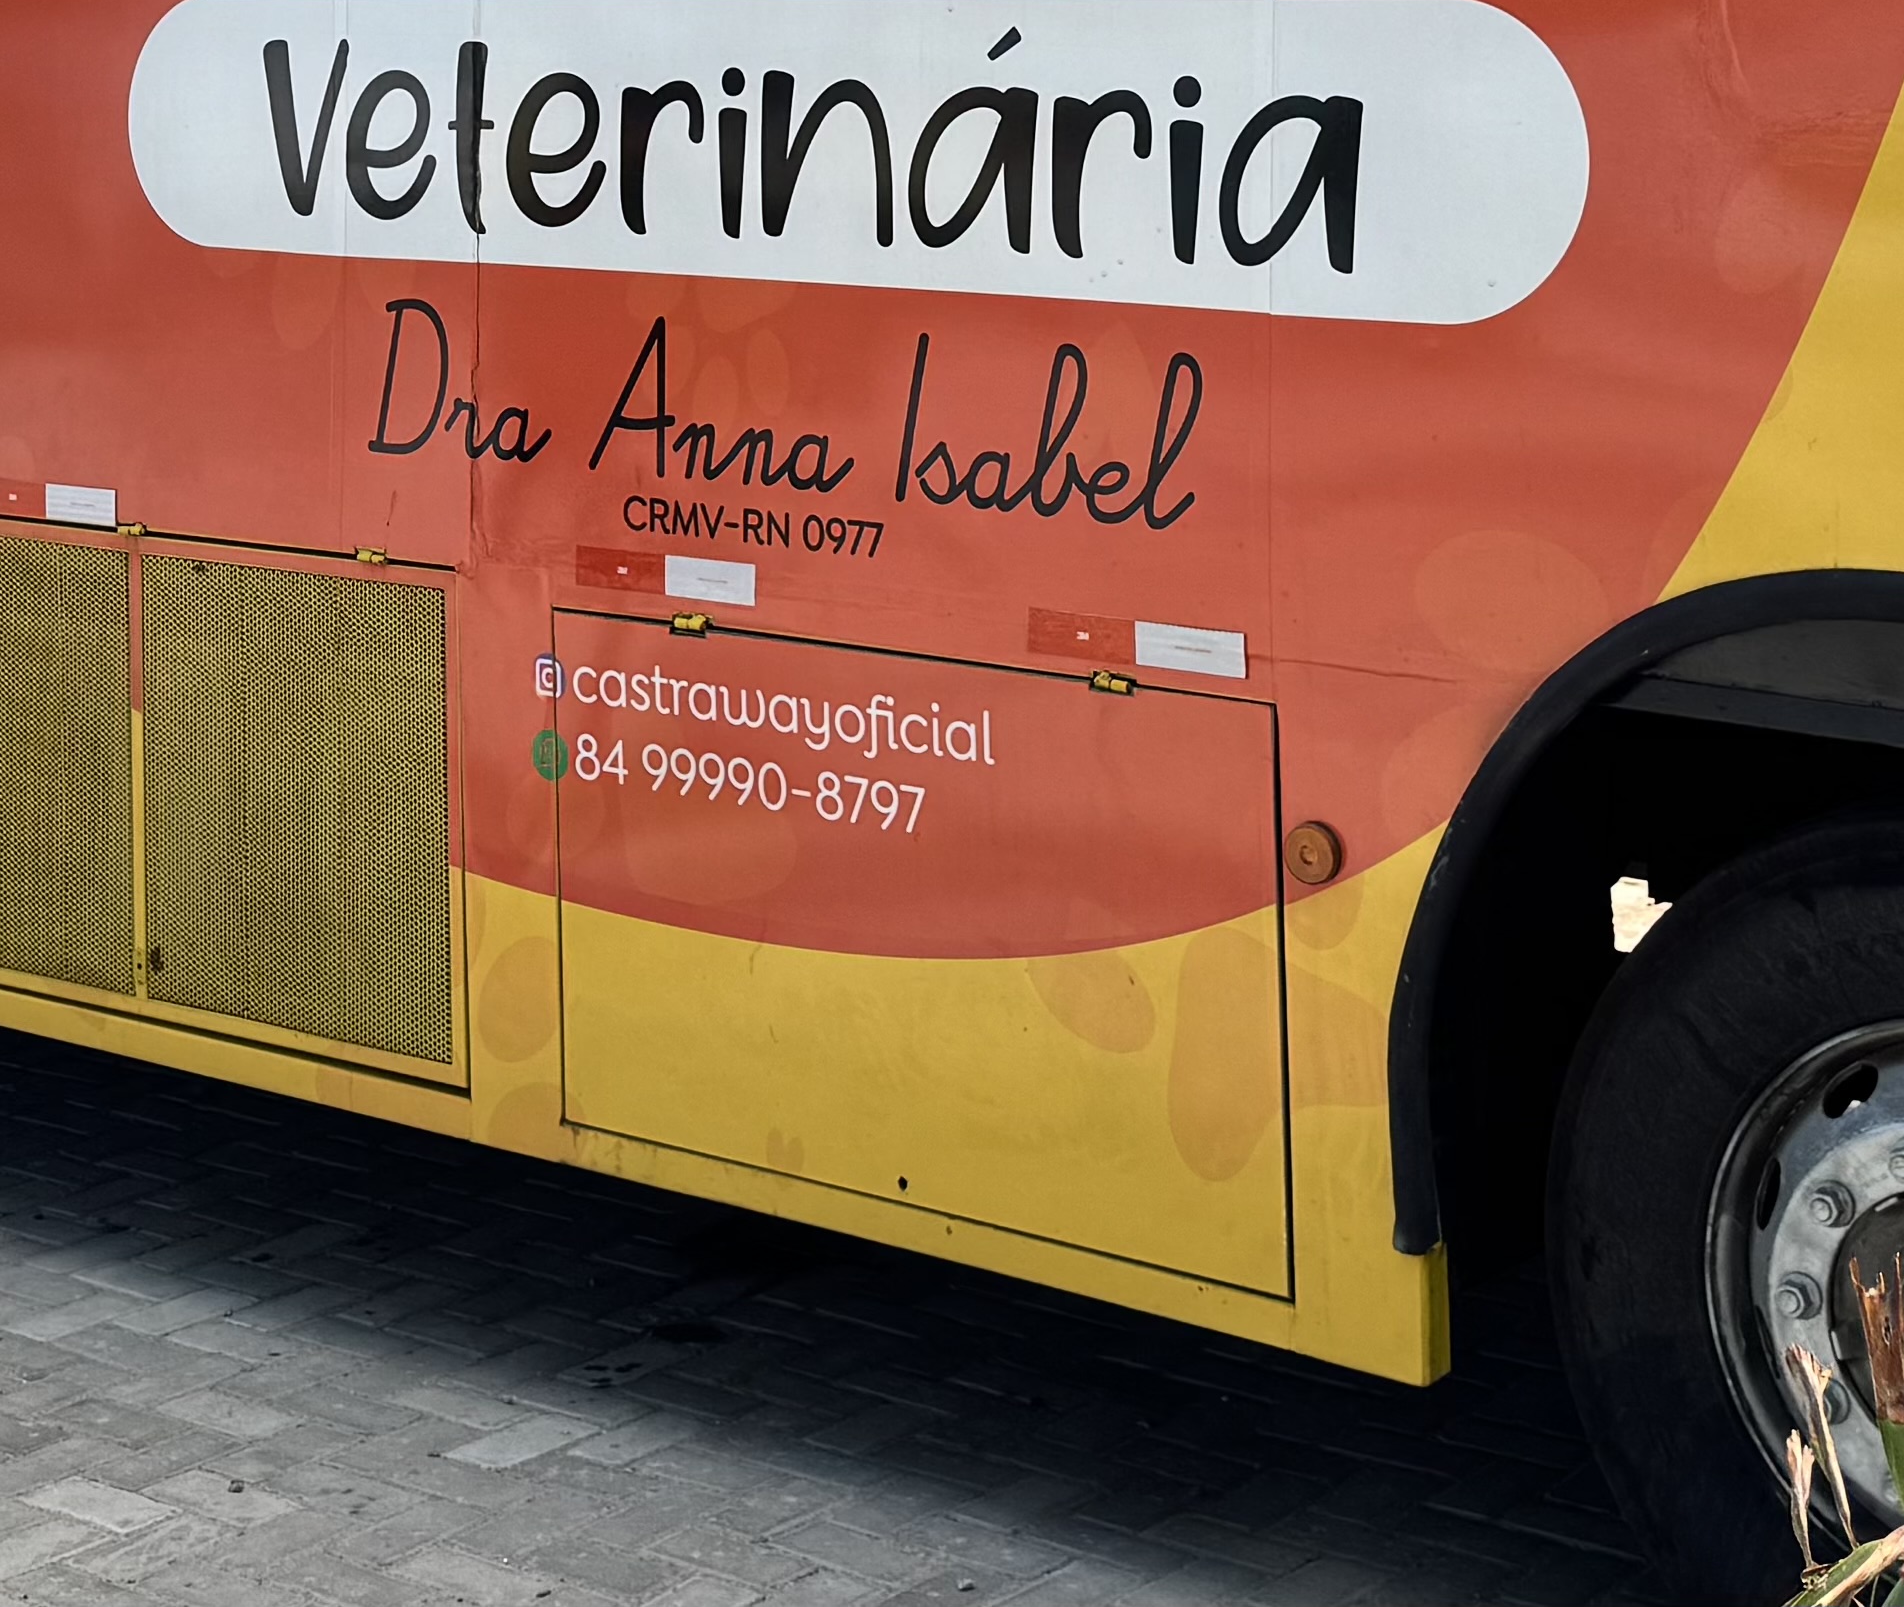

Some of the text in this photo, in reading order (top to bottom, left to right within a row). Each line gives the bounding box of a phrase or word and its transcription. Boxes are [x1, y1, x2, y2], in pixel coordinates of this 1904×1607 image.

[263, 26, 1363, 274] Veterinária
[368, 299, 1204, 530] Dra Anna Isabel
[622, 495, 884, 558] CRMV-RN 0977
[573, 664, 995, 765] castrawayoficial
[575, 733, 926, 833] 84 99990-8797
